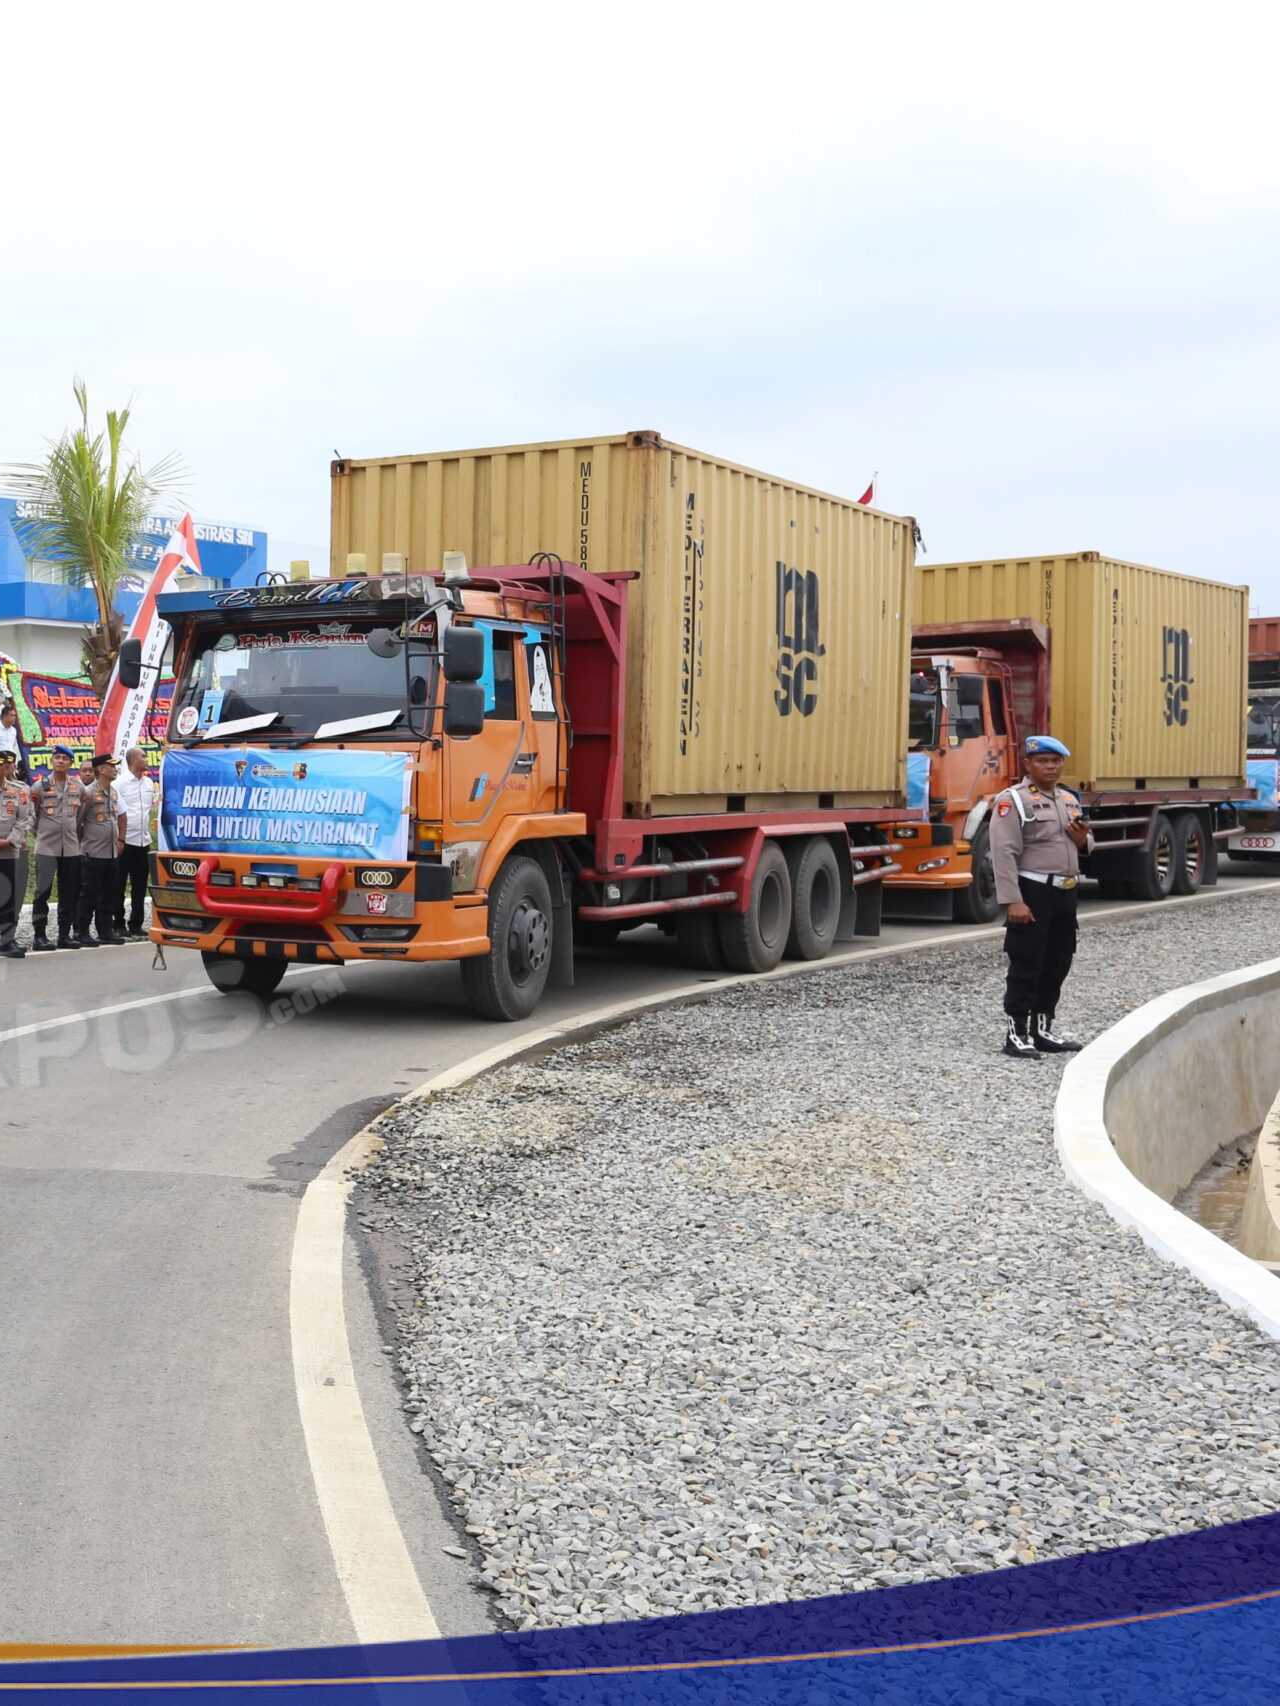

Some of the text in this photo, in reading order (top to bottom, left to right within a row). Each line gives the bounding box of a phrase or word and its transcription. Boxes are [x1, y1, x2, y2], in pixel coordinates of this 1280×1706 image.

[208, 581, 368, 608] Bismillah
[204, 704, 214, 723] 1
[182, 785, 368, 816] BANTUAN KEMANUSIAAN
[176, 814, 380, 848] POLRI UNTUK MASYARAKAT
